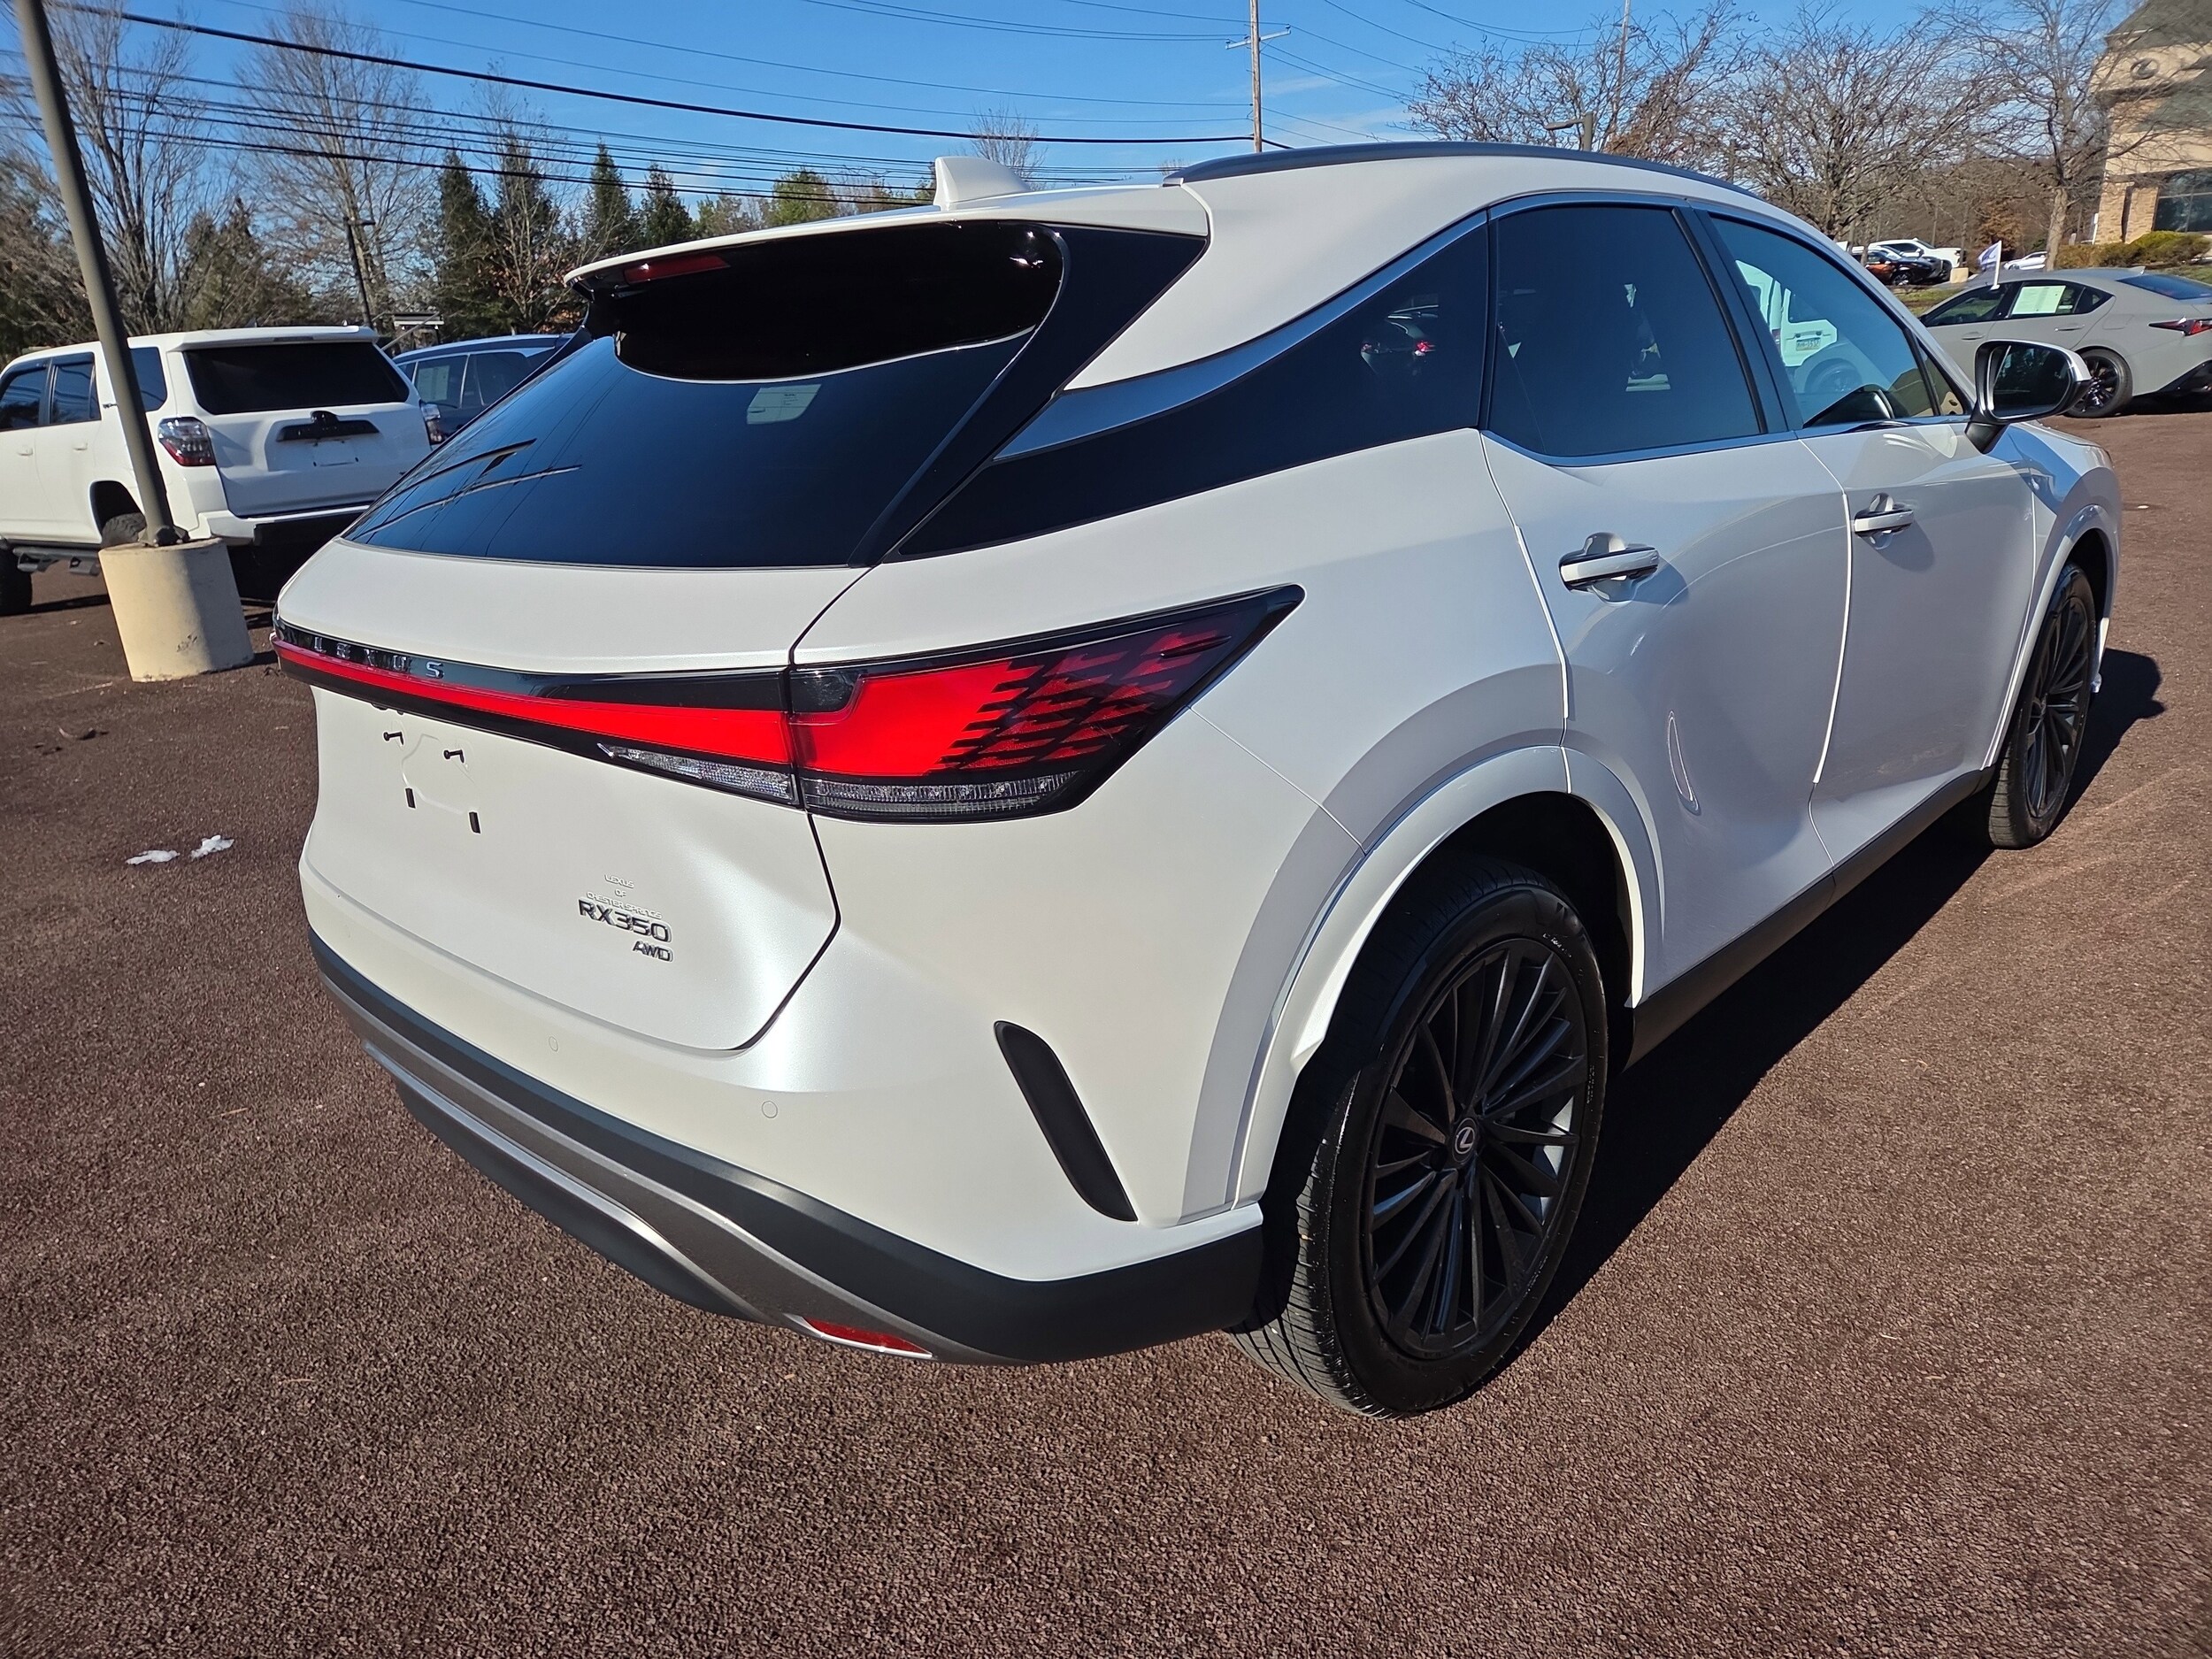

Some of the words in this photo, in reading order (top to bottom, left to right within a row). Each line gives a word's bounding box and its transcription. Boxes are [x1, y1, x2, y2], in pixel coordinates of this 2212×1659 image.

[314, 637, 444, 679] LEXUS
[604, 874, 634, 888] LEXUS
[614, 888, 627, 897] OF
[633, 941, 673, 963] AWD
